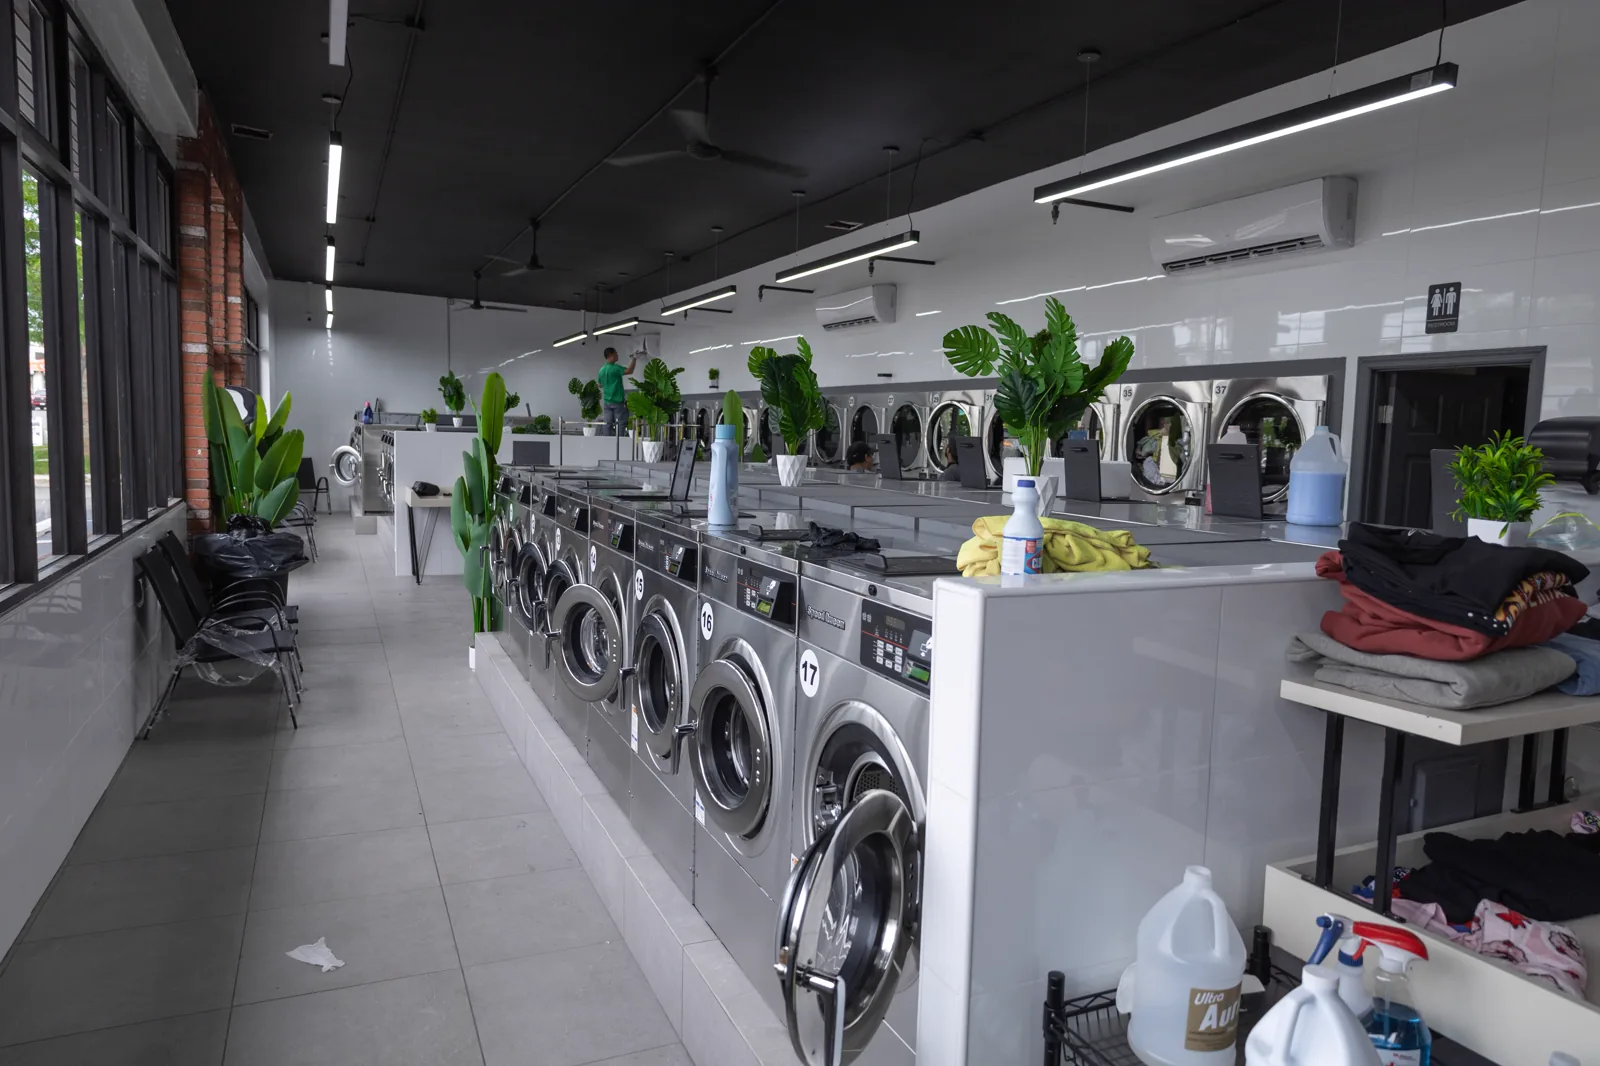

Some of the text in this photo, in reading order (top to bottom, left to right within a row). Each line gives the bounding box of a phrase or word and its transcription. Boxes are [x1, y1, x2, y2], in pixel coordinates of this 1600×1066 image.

[1123, 389, 1133, 398] 35
[1215, 385, 1227, 395] 37
[636, 577, 643, 593] 15
[702, 611, 712, 631] 16
[807, 605, 826, 622] Speed
[802, 660, 818, 686] 17
